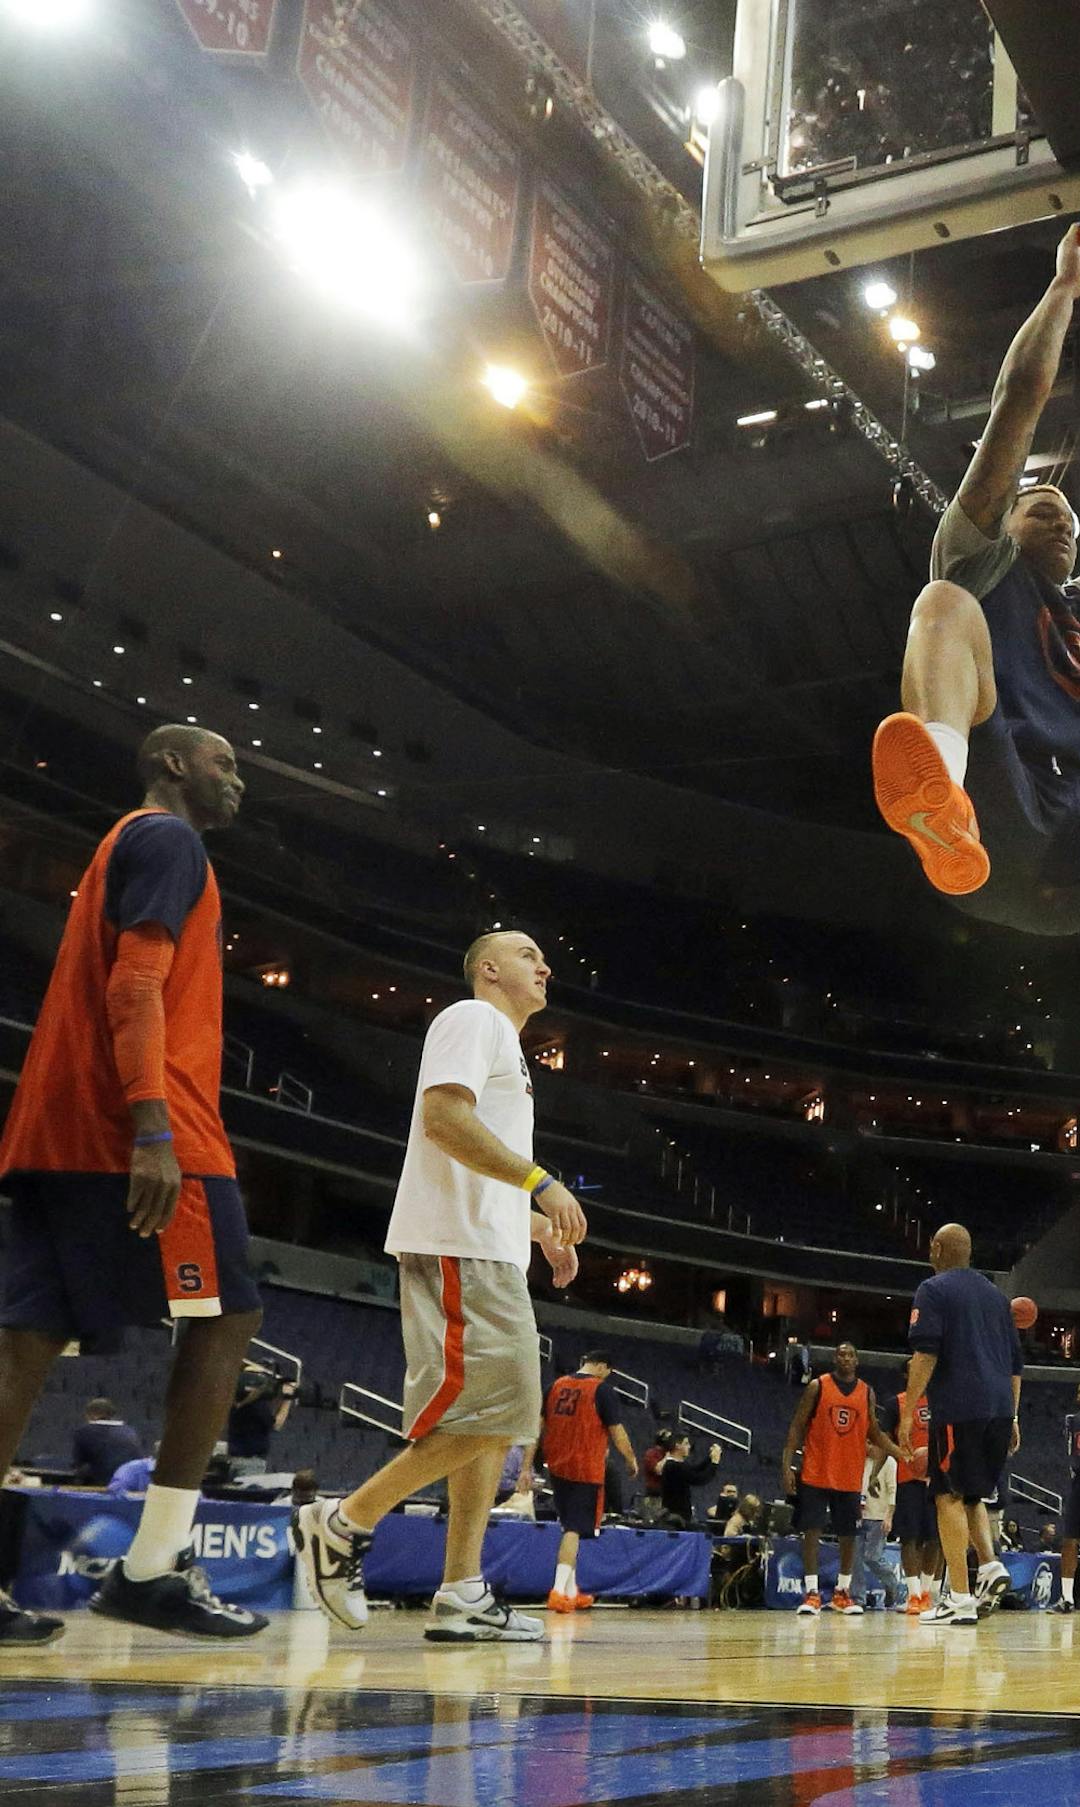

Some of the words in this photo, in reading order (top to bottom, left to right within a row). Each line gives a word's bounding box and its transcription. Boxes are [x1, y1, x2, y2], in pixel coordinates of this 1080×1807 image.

[177, 1263, 203, 1293] S
[554, 1388, 582, 1416] 23
[837, 1408, 850, 1426] S
